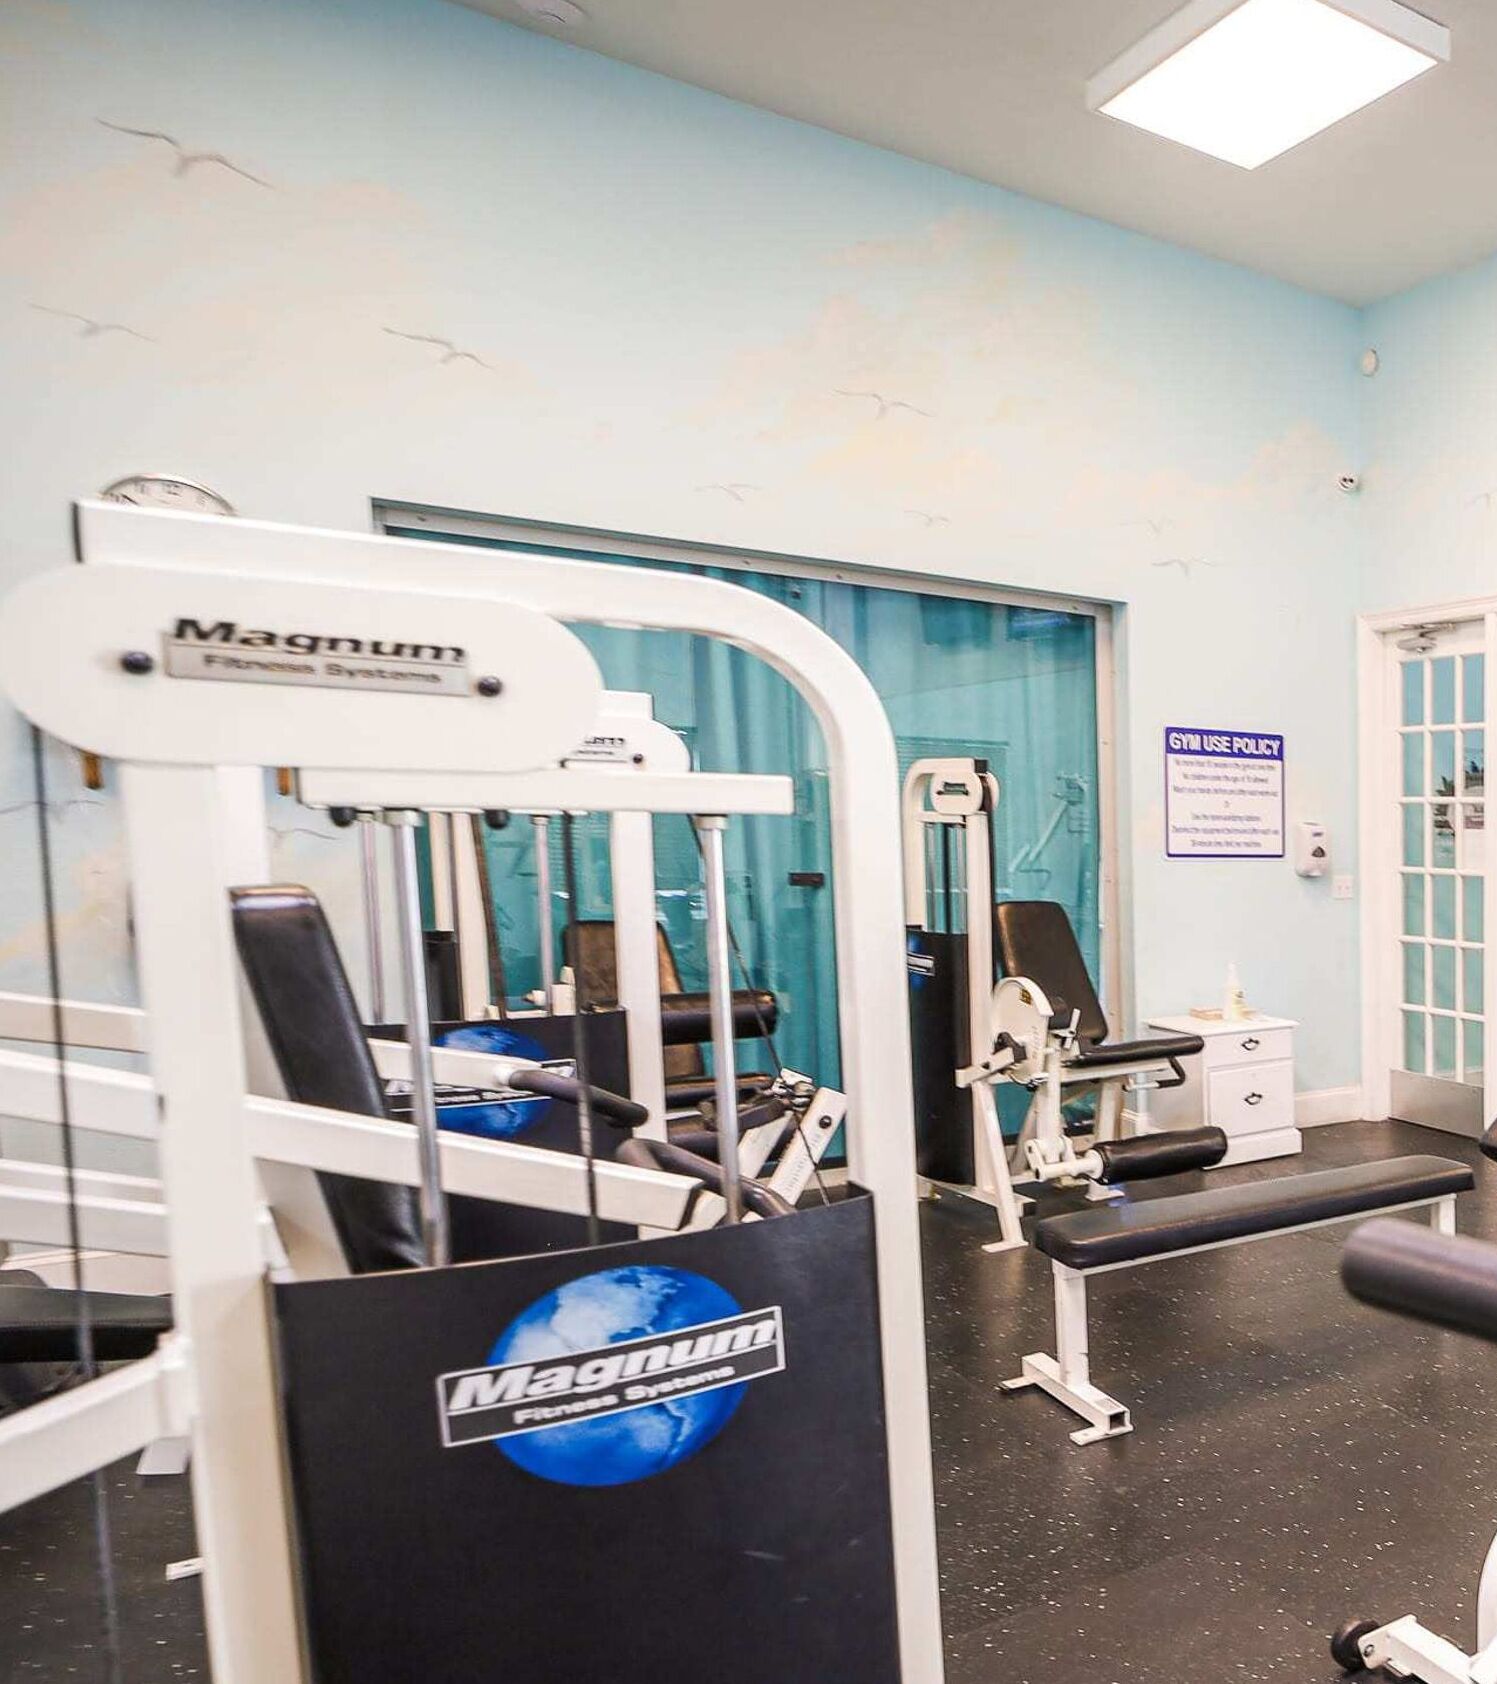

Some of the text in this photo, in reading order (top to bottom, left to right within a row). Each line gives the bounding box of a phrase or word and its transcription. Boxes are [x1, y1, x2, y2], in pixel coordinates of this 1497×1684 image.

[174, 618, 465, 662] Magnum
[203, 654, 442, 684] Fitness Systems
[1169, 732, 1280, 756] GYM USE POLICY
[449, 1318, 778, 1411] Magnum
[512, 1365, 735, 1425] Fitness Systems
